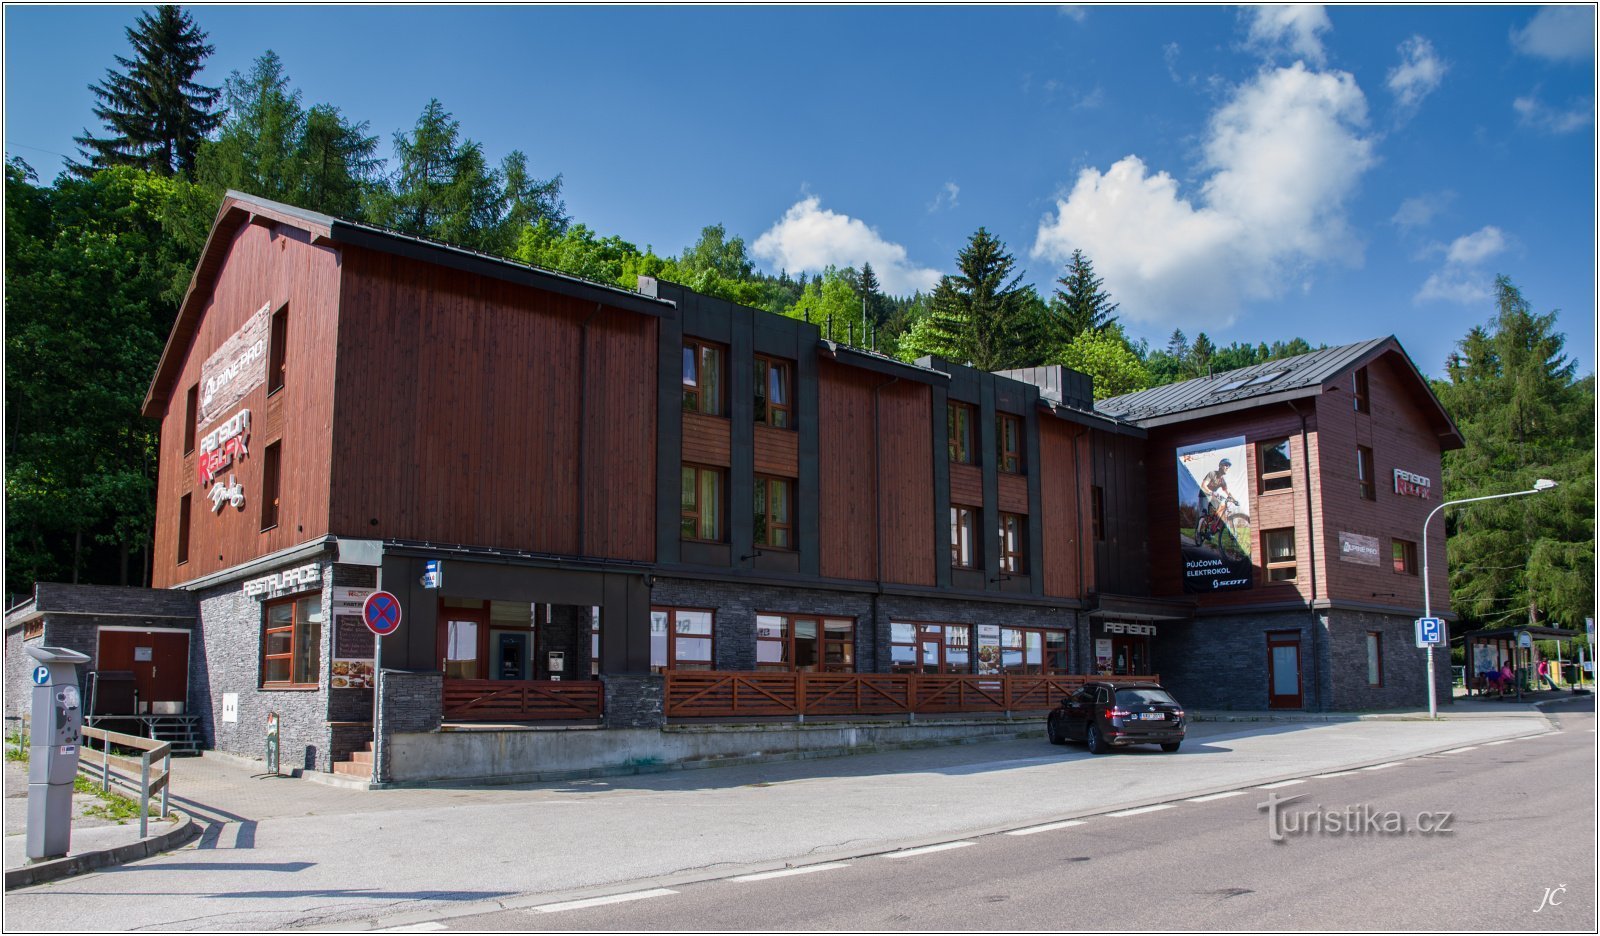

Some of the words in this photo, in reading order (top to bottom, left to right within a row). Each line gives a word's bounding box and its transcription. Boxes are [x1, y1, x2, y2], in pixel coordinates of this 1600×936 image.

[199, 408, 250, 456] PENSION
[199, 431, 248, 485] RELAX
[1393, 468, 1431, 488] PENSION
[1186, 559, 1222, 568] PŮJČOVNA
[1186, 567, 1230, 577] ELEKTROKOL
[242, 562, 320, 598] RESTAURACE
[1219, 578, 1248, 586] SCOTT
[1103, 621, 1157, 637] PENSION
